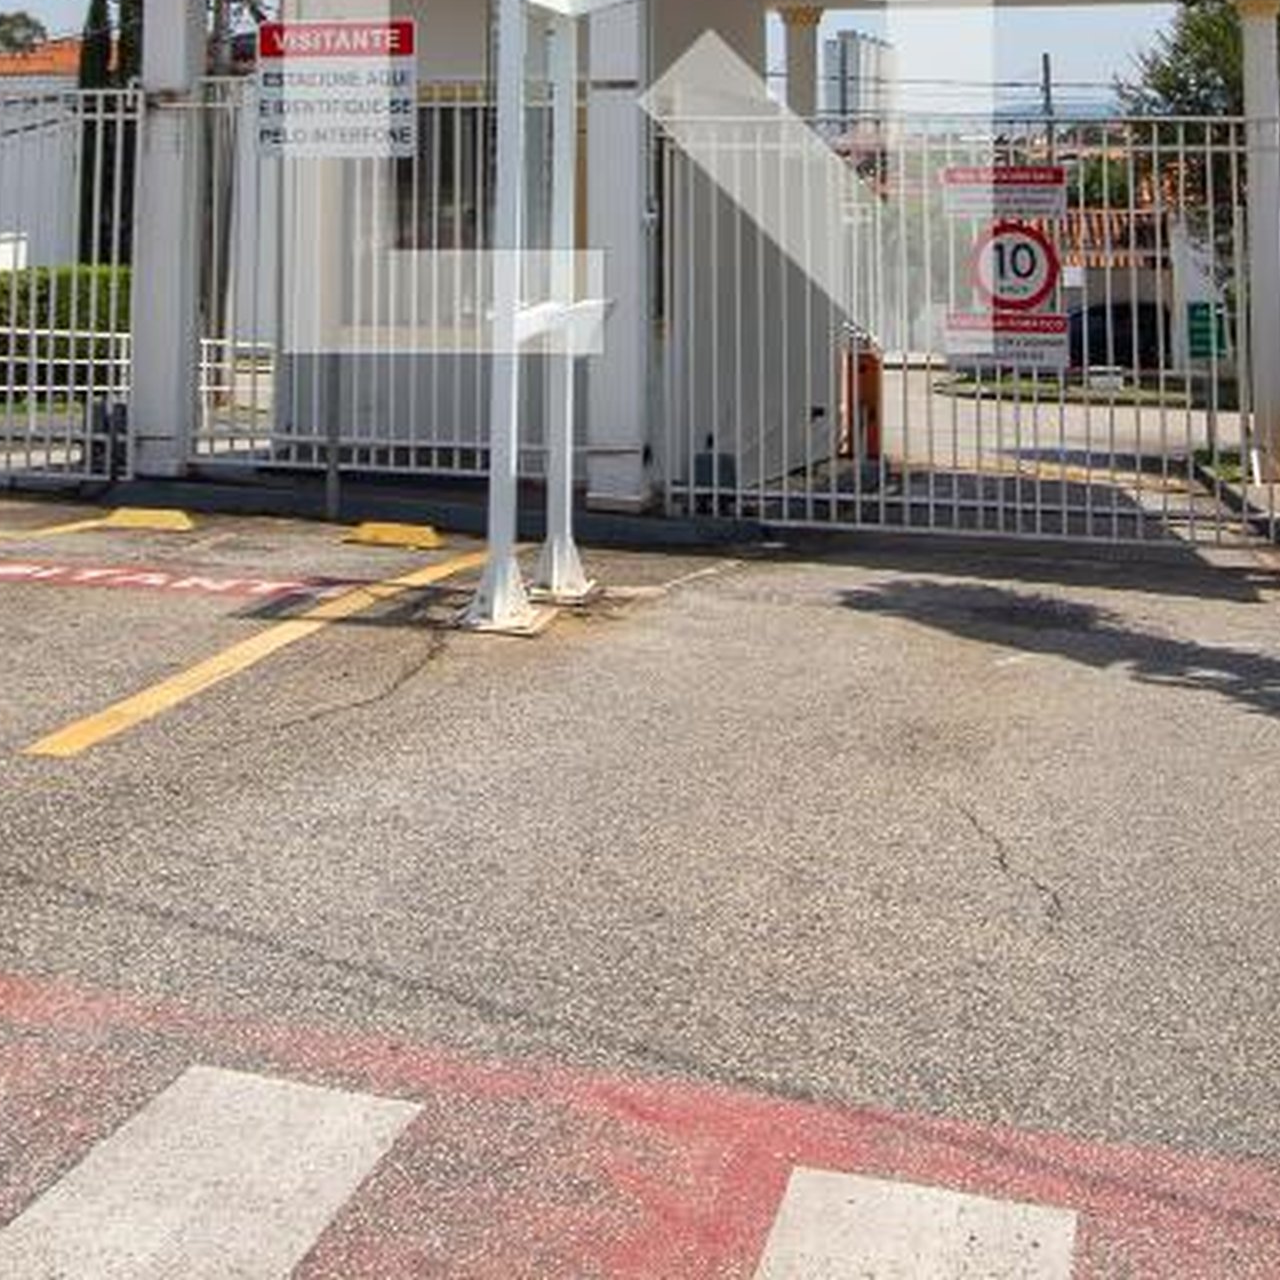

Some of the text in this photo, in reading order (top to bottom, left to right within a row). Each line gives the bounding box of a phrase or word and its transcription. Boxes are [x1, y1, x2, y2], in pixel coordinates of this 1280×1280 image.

[272, 29, 401, 51] VISITANTE
[260, 127, 412, 145] PELO INTERFONE
[993, 242, 1037, 280] 10
